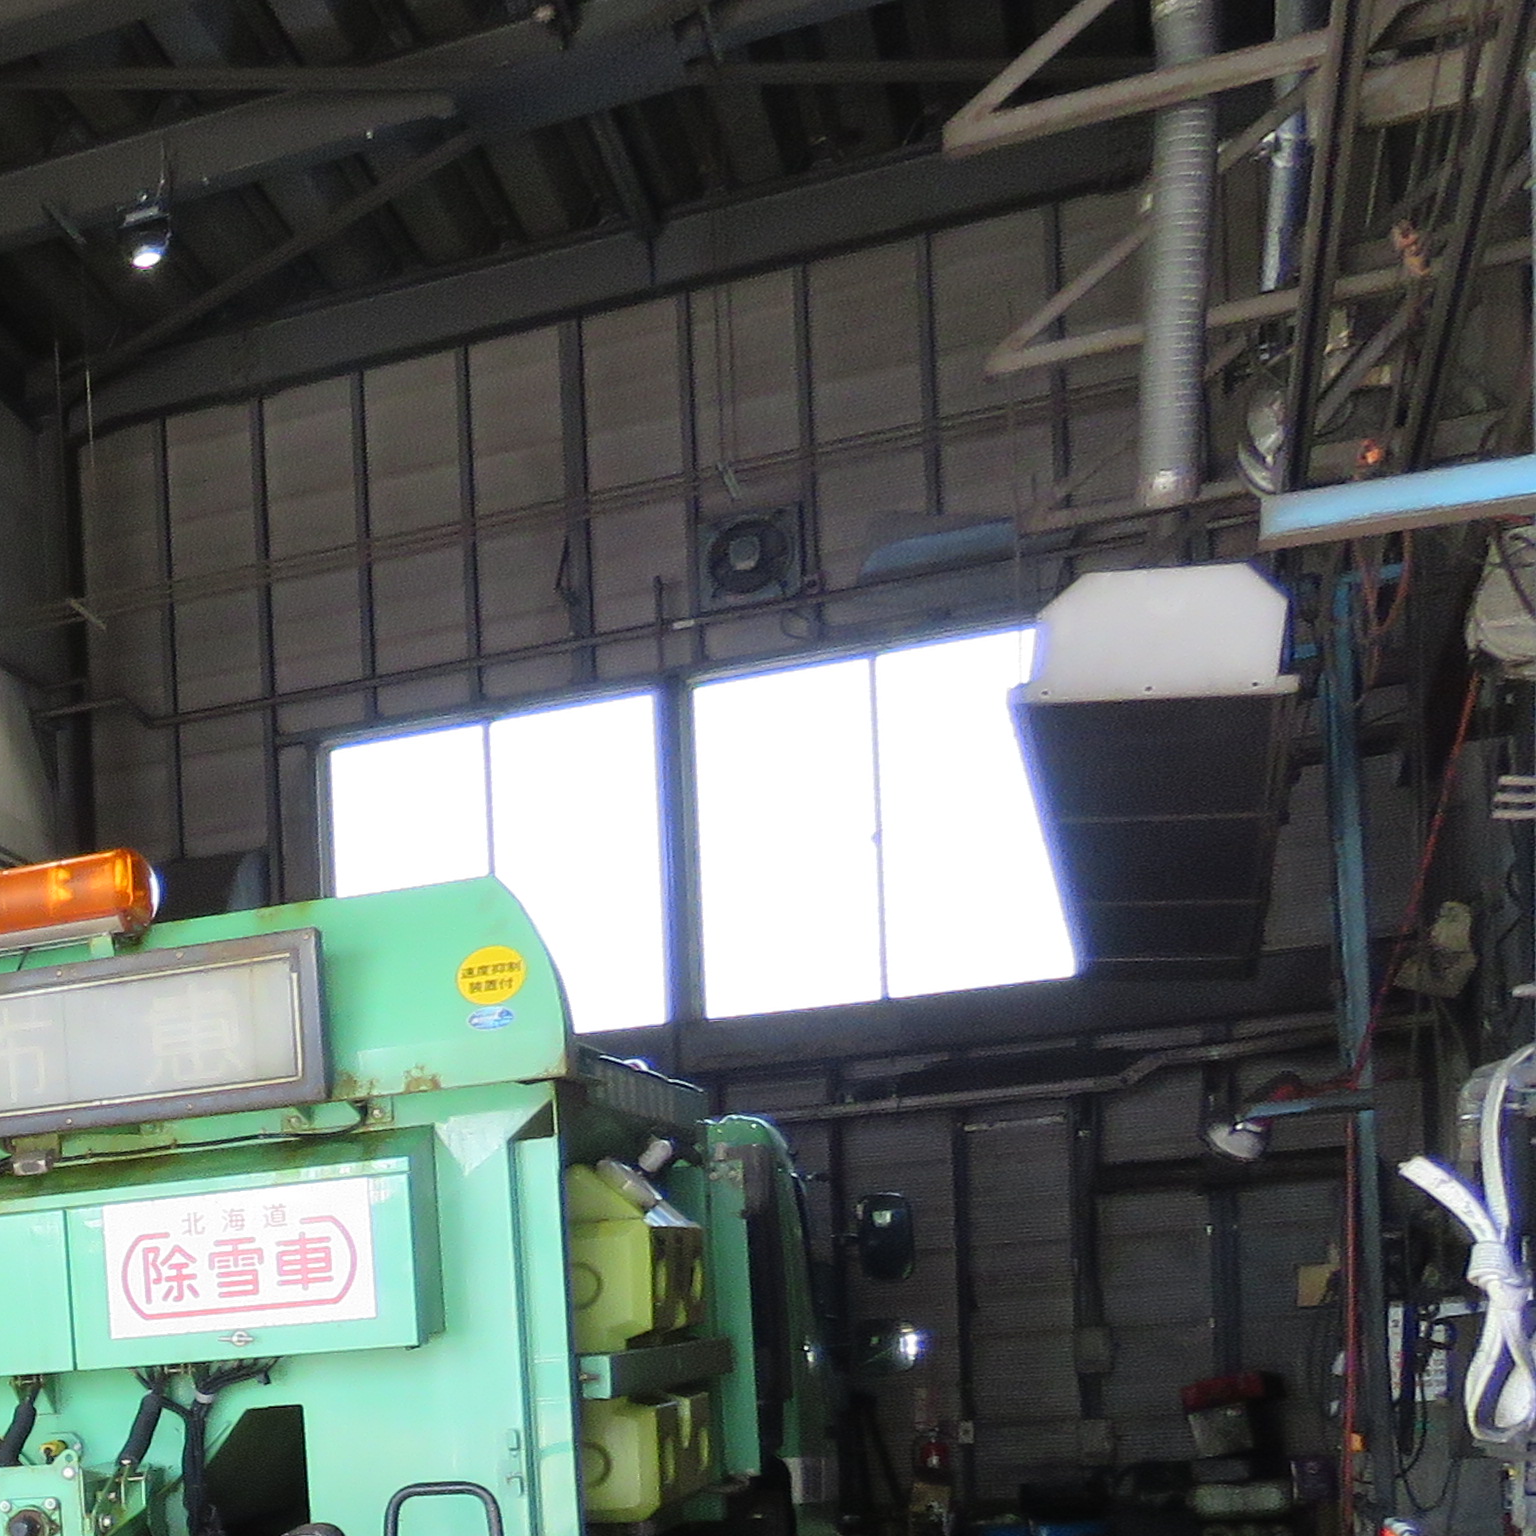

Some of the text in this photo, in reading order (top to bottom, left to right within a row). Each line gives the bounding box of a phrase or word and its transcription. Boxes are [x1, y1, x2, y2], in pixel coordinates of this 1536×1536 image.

[181, 1203, 288, 1237] 北海道
[142, 1232, 334, 1305] 除雪車
